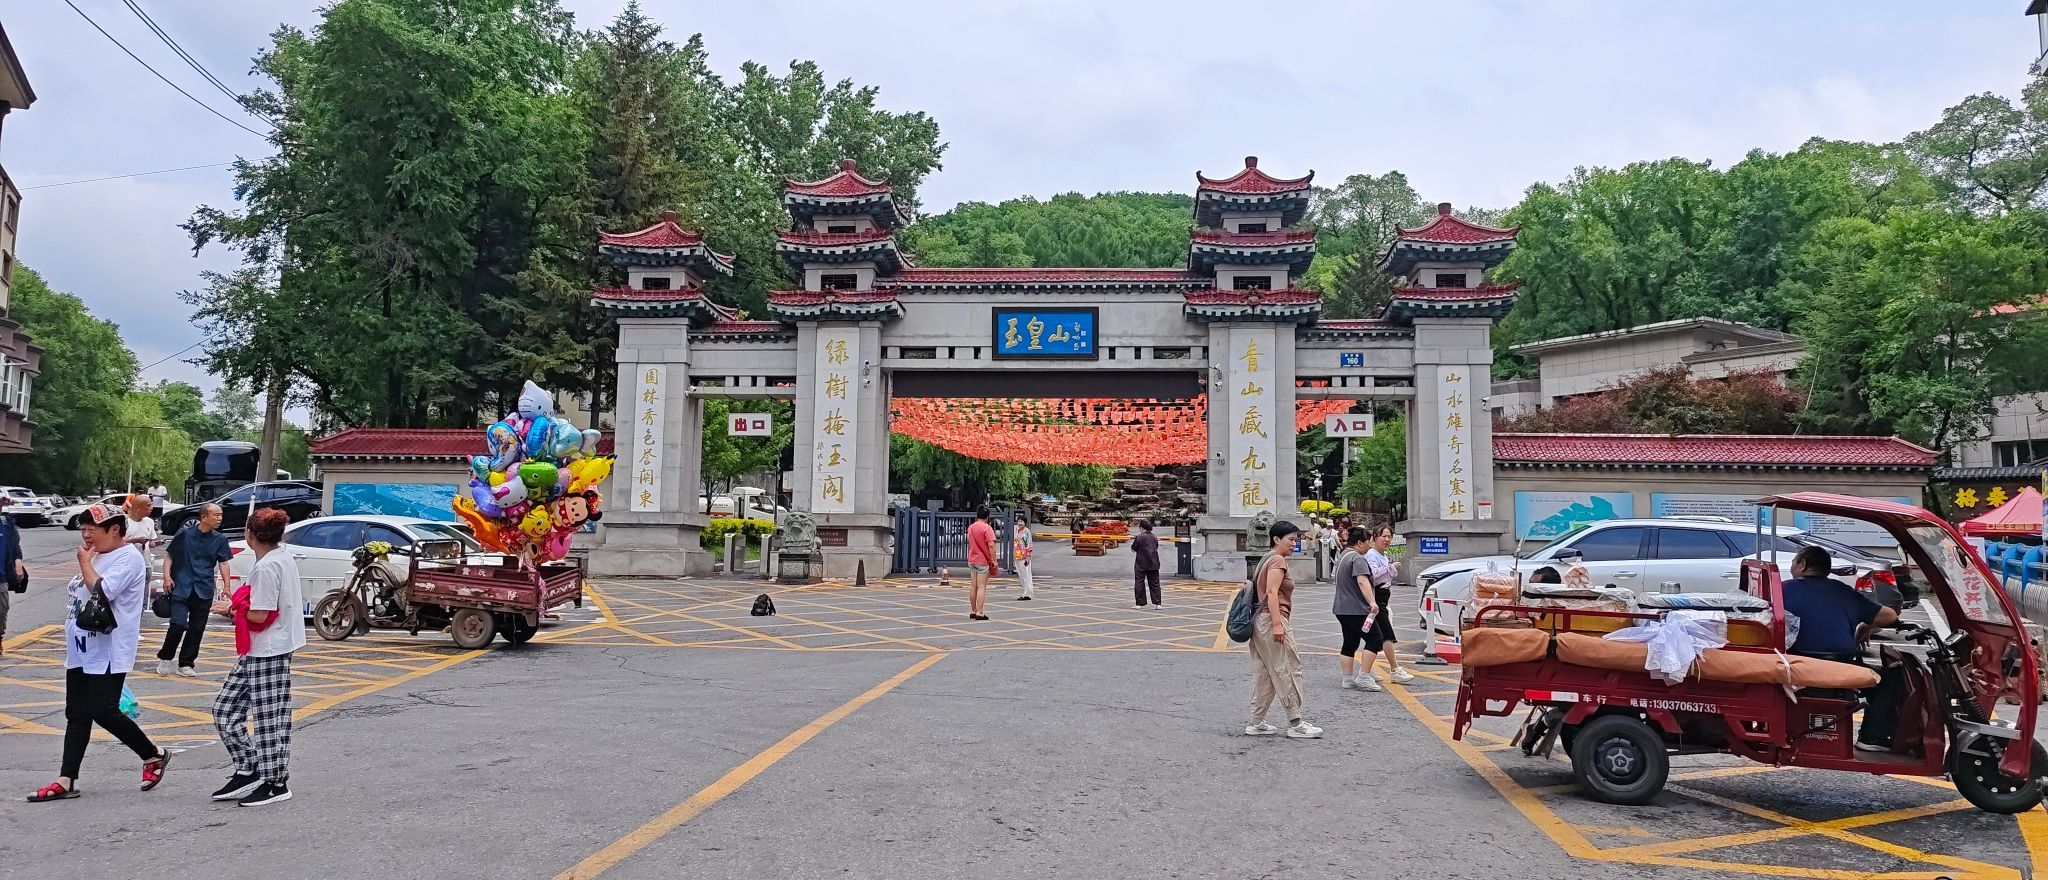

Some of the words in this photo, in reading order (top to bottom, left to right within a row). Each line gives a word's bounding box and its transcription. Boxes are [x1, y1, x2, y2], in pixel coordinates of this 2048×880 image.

[1004, 315, 1070, 351] 玉皇山
[1346, 357, 1359, 365] 160
[734, 417, 766, 432] 出口
[1333, 417, 1367, 434] 入口
[1582, 693, 1608, 704] 车行
